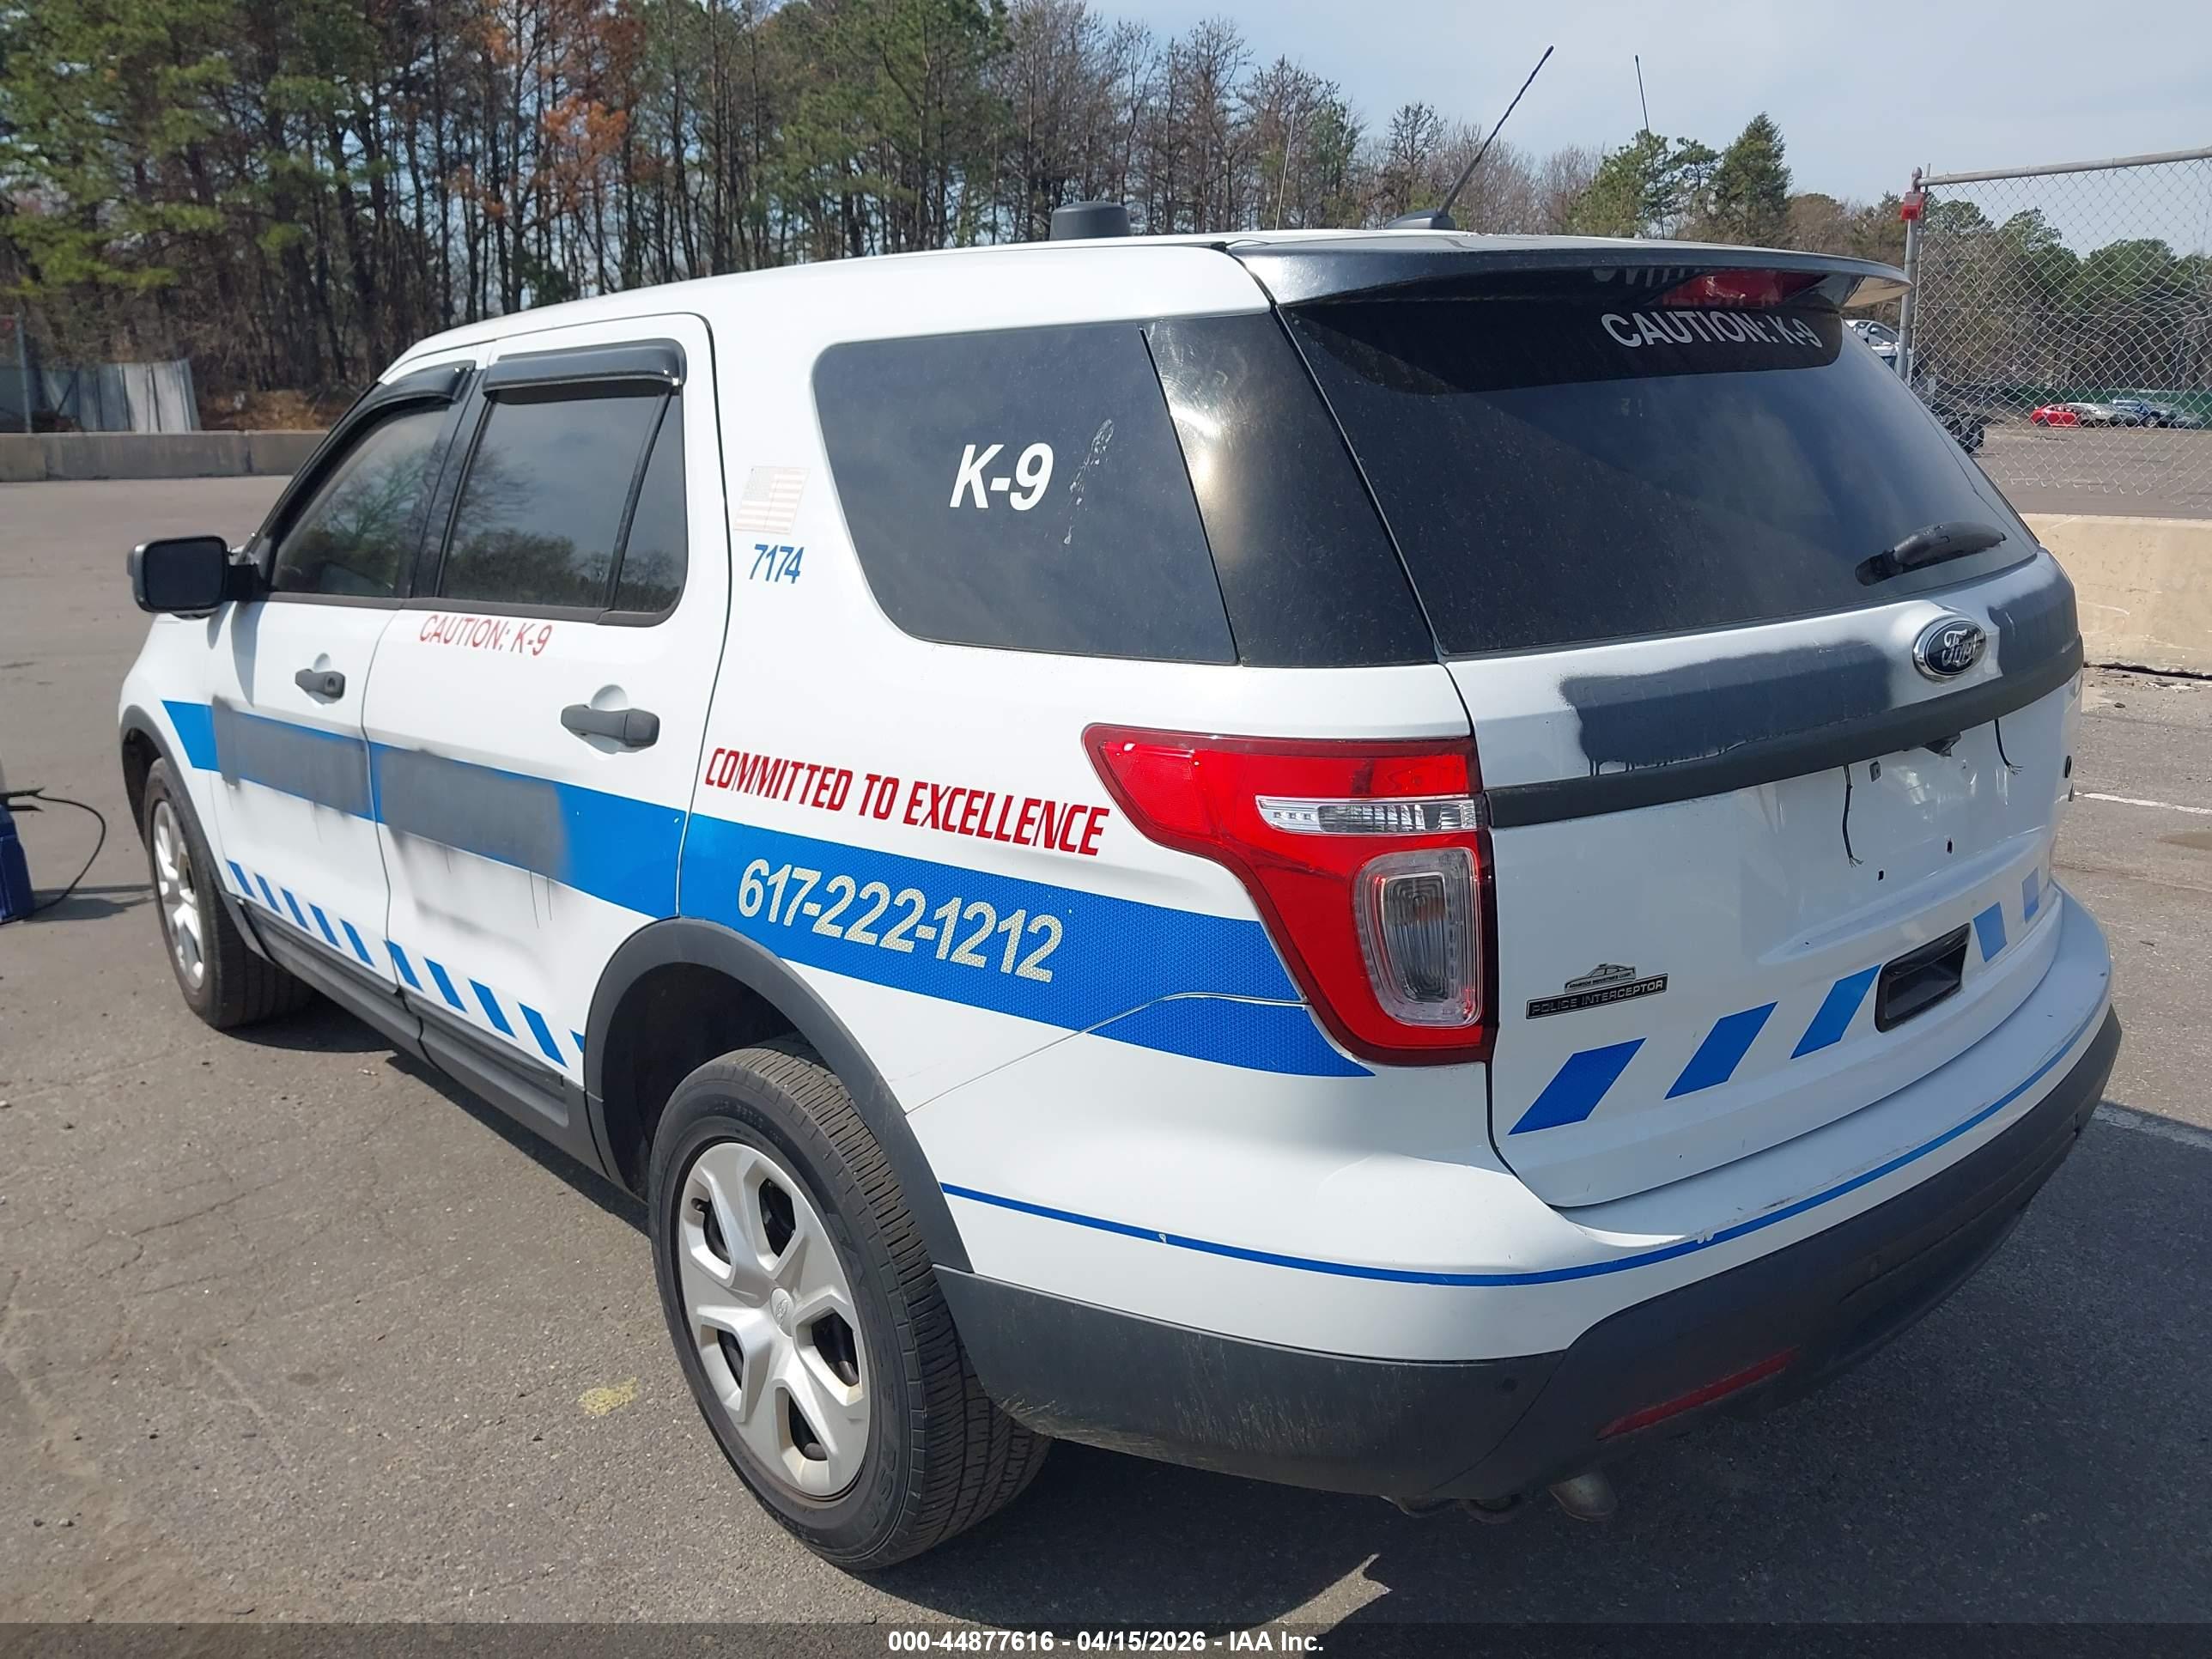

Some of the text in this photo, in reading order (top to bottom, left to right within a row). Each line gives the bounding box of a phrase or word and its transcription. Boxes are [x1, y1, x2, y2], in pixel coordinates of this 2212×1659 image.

[1601, 310, 1823, 348] CAUTION: K-9
[948, 441, 1054, 512] K-9
[749, 544, 805, 585] 7174
[419, 614, 554, 656] CAUTION: K-9
[1941, 628, 1978, 667] Ford
[704, 747, 1110, 856] COMMITTED TO EXCELLENCE
[738, 858, 1064, 983] 617-222-1212
[1531, 998, 1578, 1014] POLICE
[1581, 979, 1663, 1005] INTERCEPTOR
